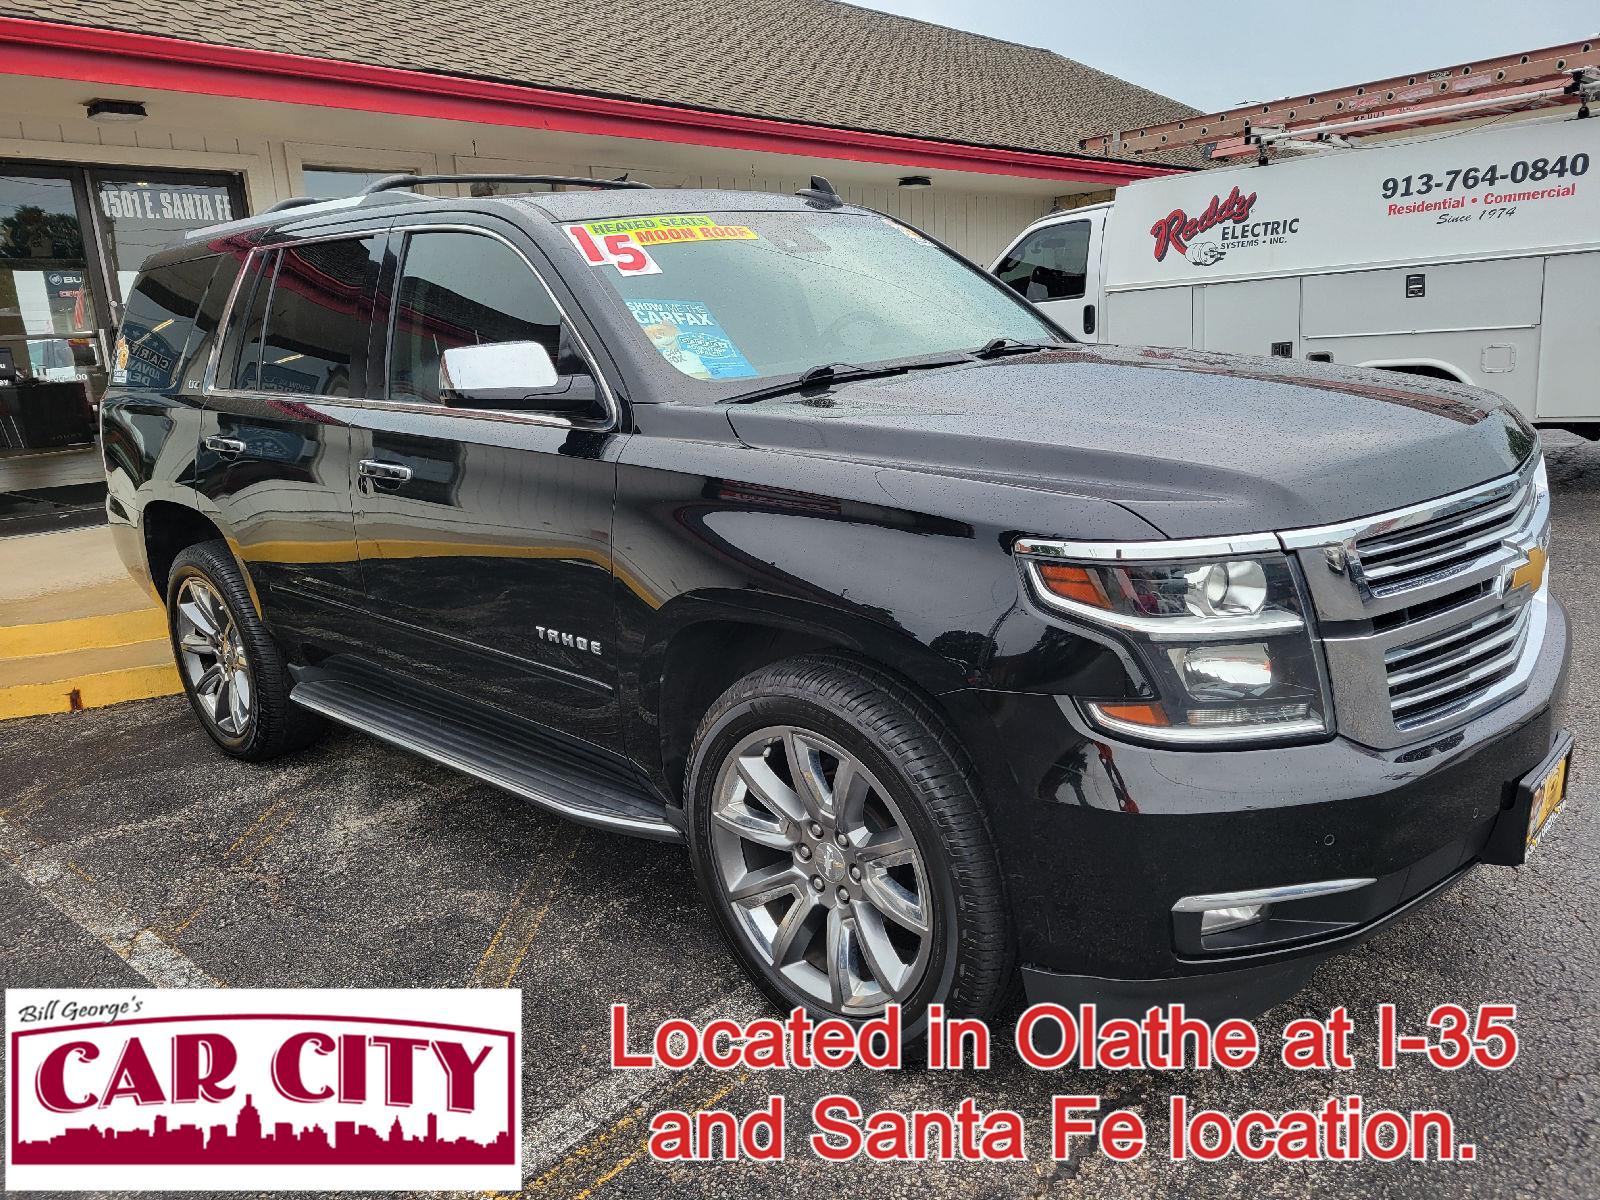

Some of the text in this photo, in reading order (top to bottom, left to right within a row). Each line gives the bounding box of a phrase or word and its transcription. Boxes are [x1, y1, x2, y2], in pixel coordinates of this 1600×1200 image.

[1381, 152, 1590, 199] 913-764-0840
[101, 190, 234, 221] 1501 E. SANTA FE
[1387, 183, 1576, 217] Residential Commercial
[591, 216, 709, 234] HEATED SEATS
[1150, 185, 1258, 262] Reddy
[1436, 206, 1516, 226] Since 1974
[634, 225, 751, 243] MOON ROOF
[1221, 217, 1300, 241] ELECTRIC
[1220, 236, 1288, 251] SYSTEMS INC.
[626, 301, 706, 314] SHOW ME THE
[632, 311, 715, 327] CARFAX
[535, 625, 602, 656] TAHOE
